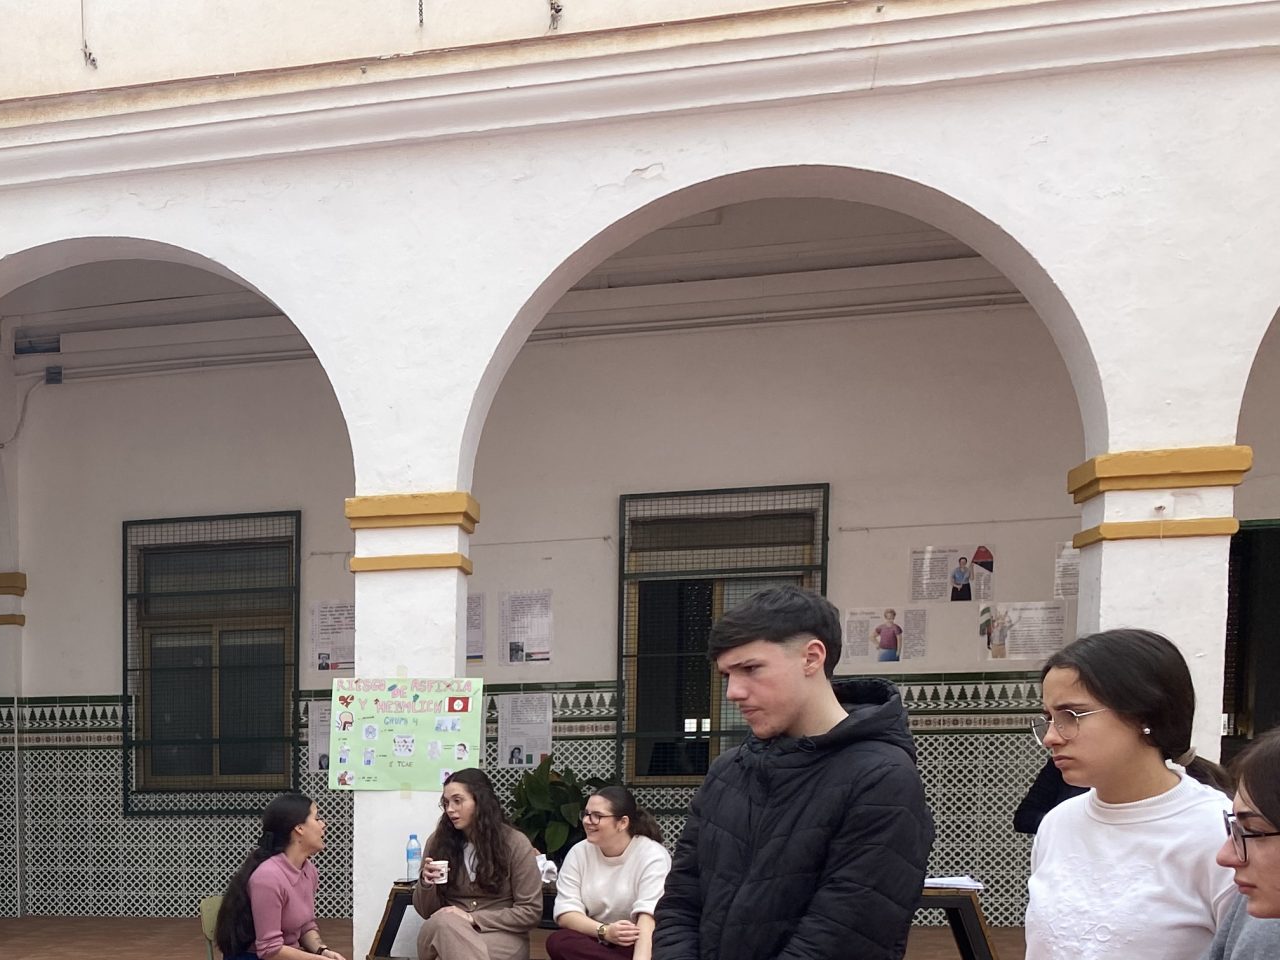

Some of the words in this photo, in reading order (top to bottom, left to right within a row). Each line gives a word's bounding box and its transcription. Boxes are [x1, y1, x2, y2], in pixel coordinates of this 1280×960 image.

[337, 679, 386, 692] RIESGO
[391, 686, 407, 698] DE
[411, 679, 472, 693] ASFIXIA
[358, 699, 367, 710] Y
[376, 699, 442, 713] HEIMLICH
